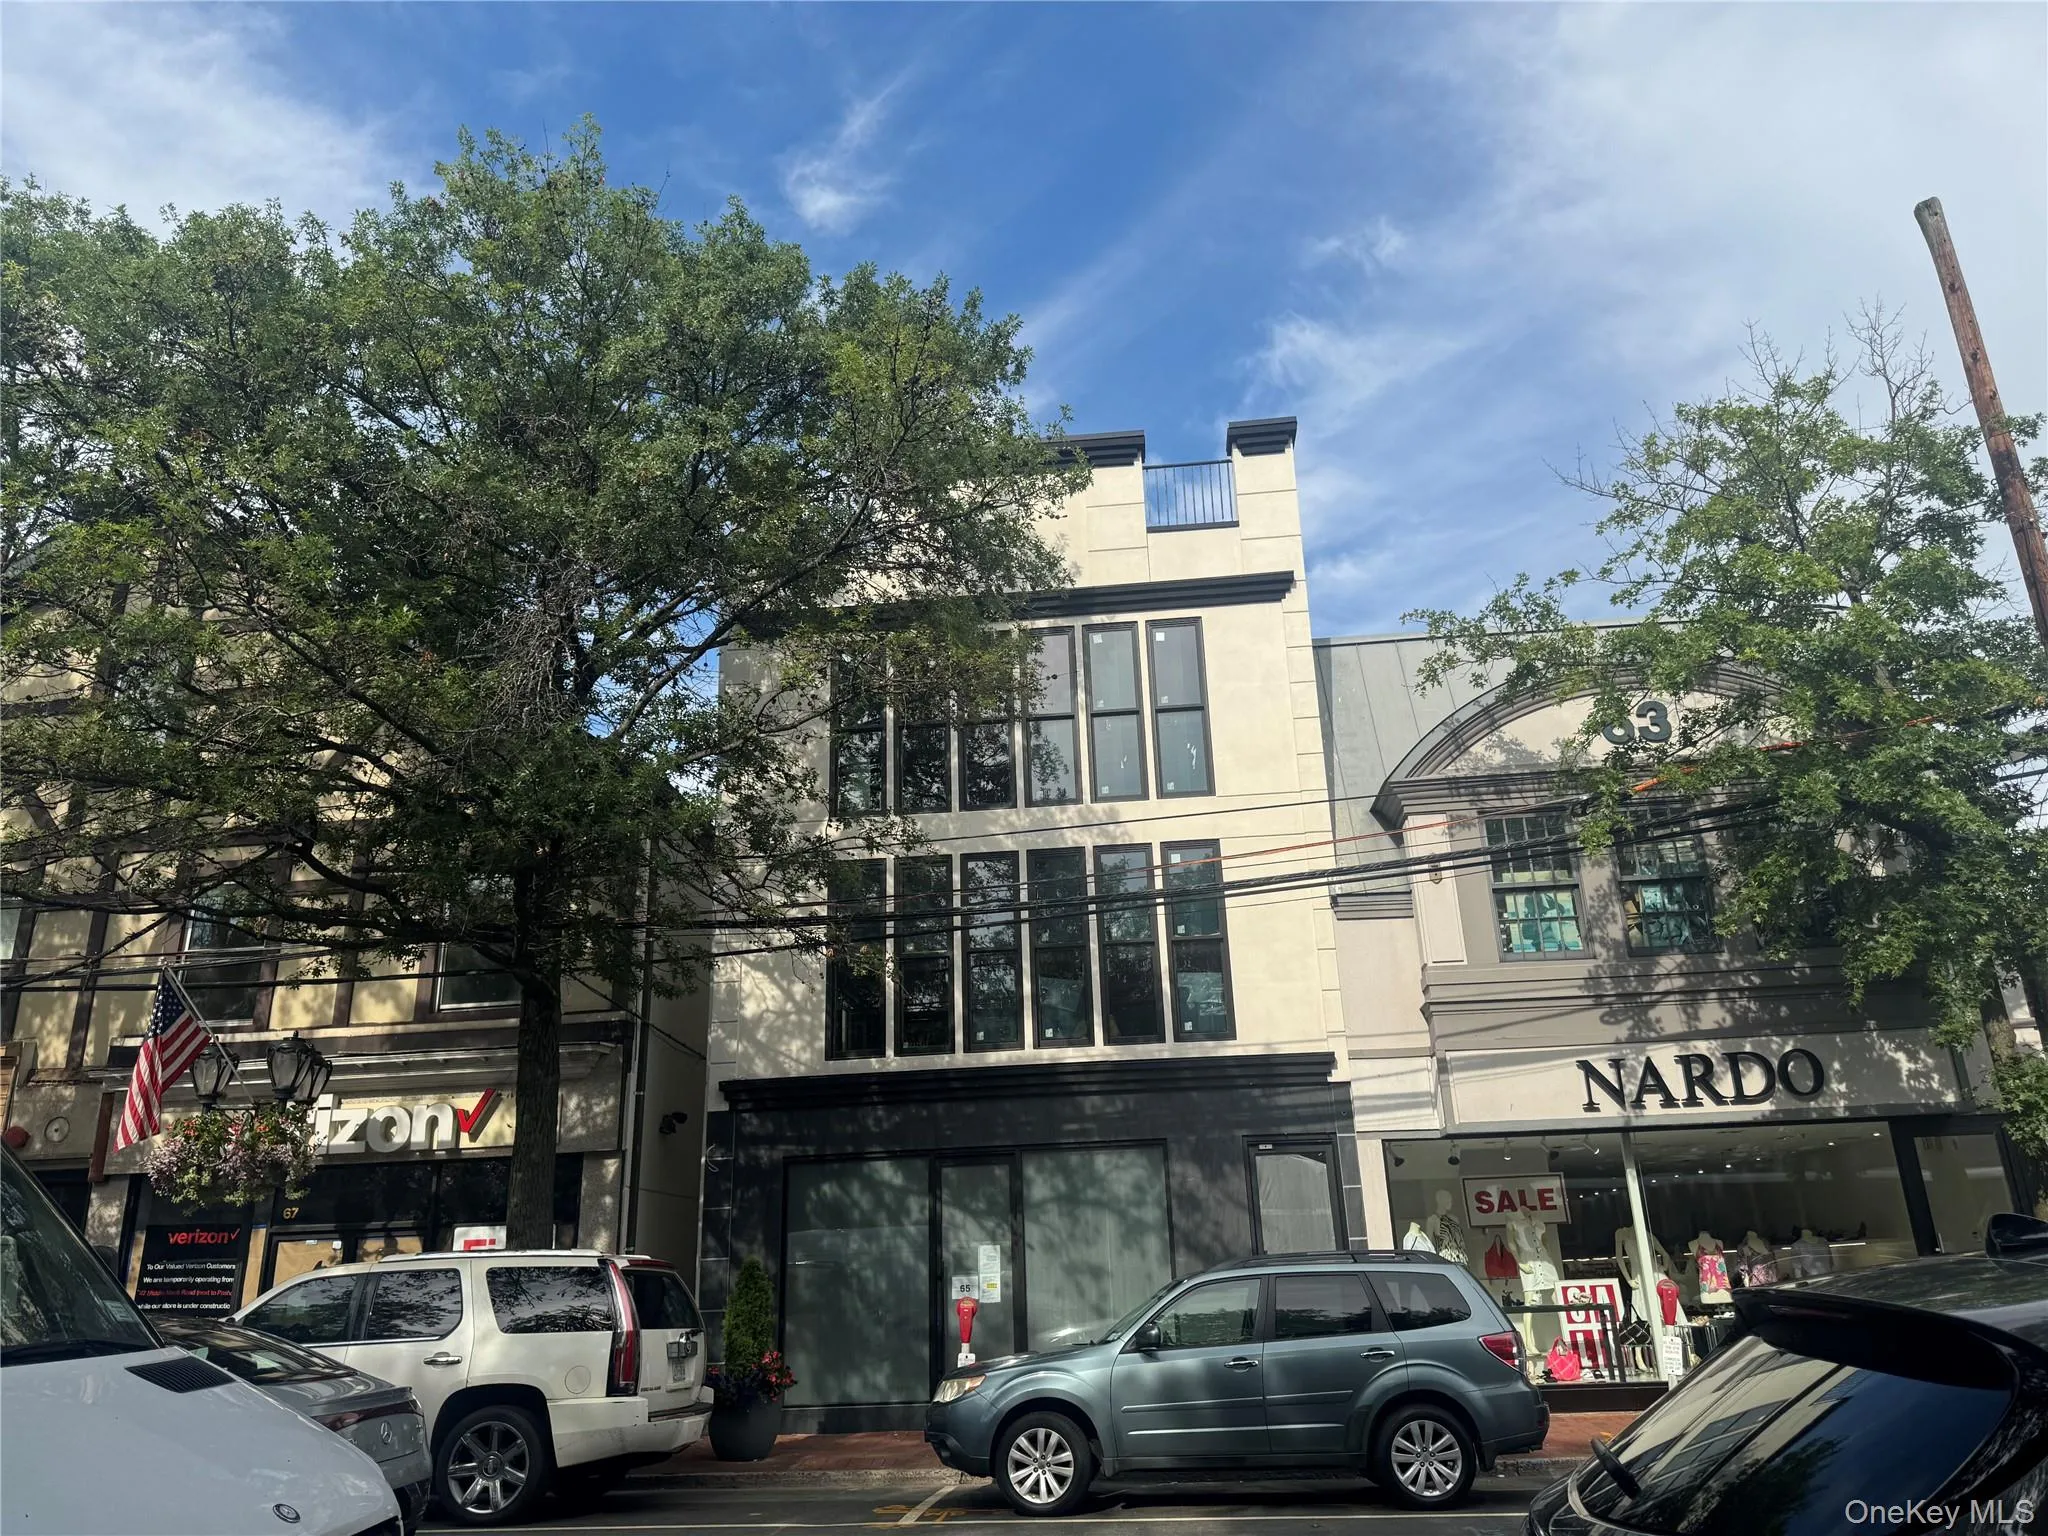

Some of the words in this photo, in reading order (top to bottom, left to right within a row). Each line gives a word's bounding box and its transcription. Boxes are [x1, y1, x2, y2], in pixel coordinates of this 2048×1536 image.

[1575, 1048, 1825, 1113] NARDO
[308, 1093, 459, 1154] izon
[1474, 1188, 1557, 1214] SALE
[282, 1207, 299, 1220] 67
[168, 1228, 229, 1244] verizon
[206, 1262, 236, 1270] Customers
[194, 1276, 221, 1284] operating
[960, 1284, 971, 1293] 65
[177, 1301, 182, 1309] is
[199, 1302, 231, 1310] constructio
